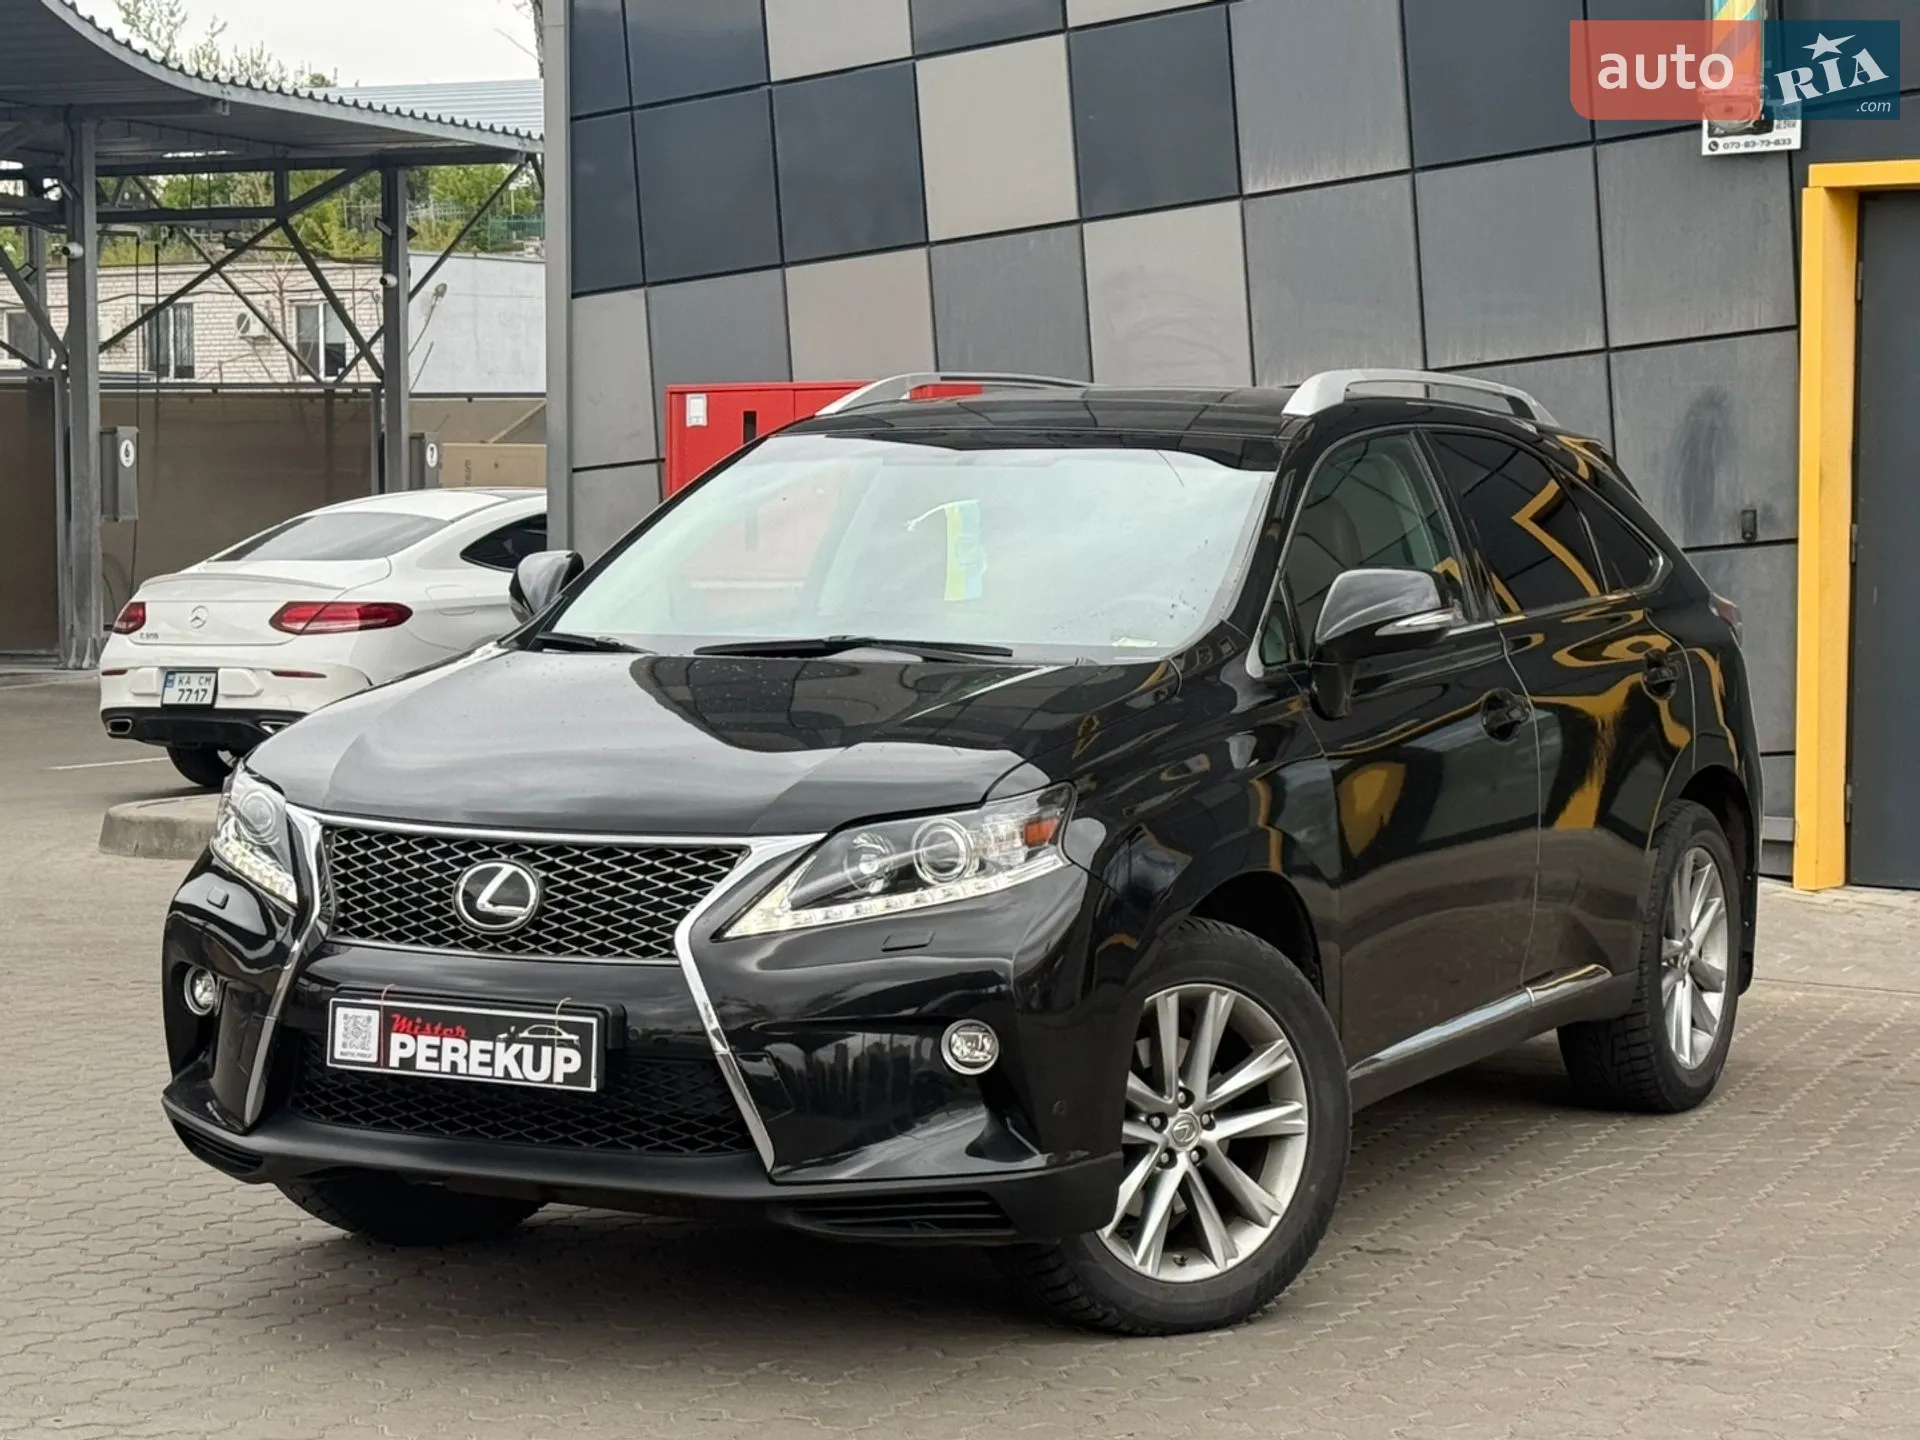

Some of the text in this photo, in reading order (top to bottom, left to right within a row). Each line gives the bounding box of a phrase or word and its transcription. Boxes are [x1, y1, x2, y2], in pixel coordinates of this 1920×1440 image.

[177, 675, 191, 686] KA
[177, 688, 209, 702] 7717
[388, 1031, 583, 1084] PEREKUP
